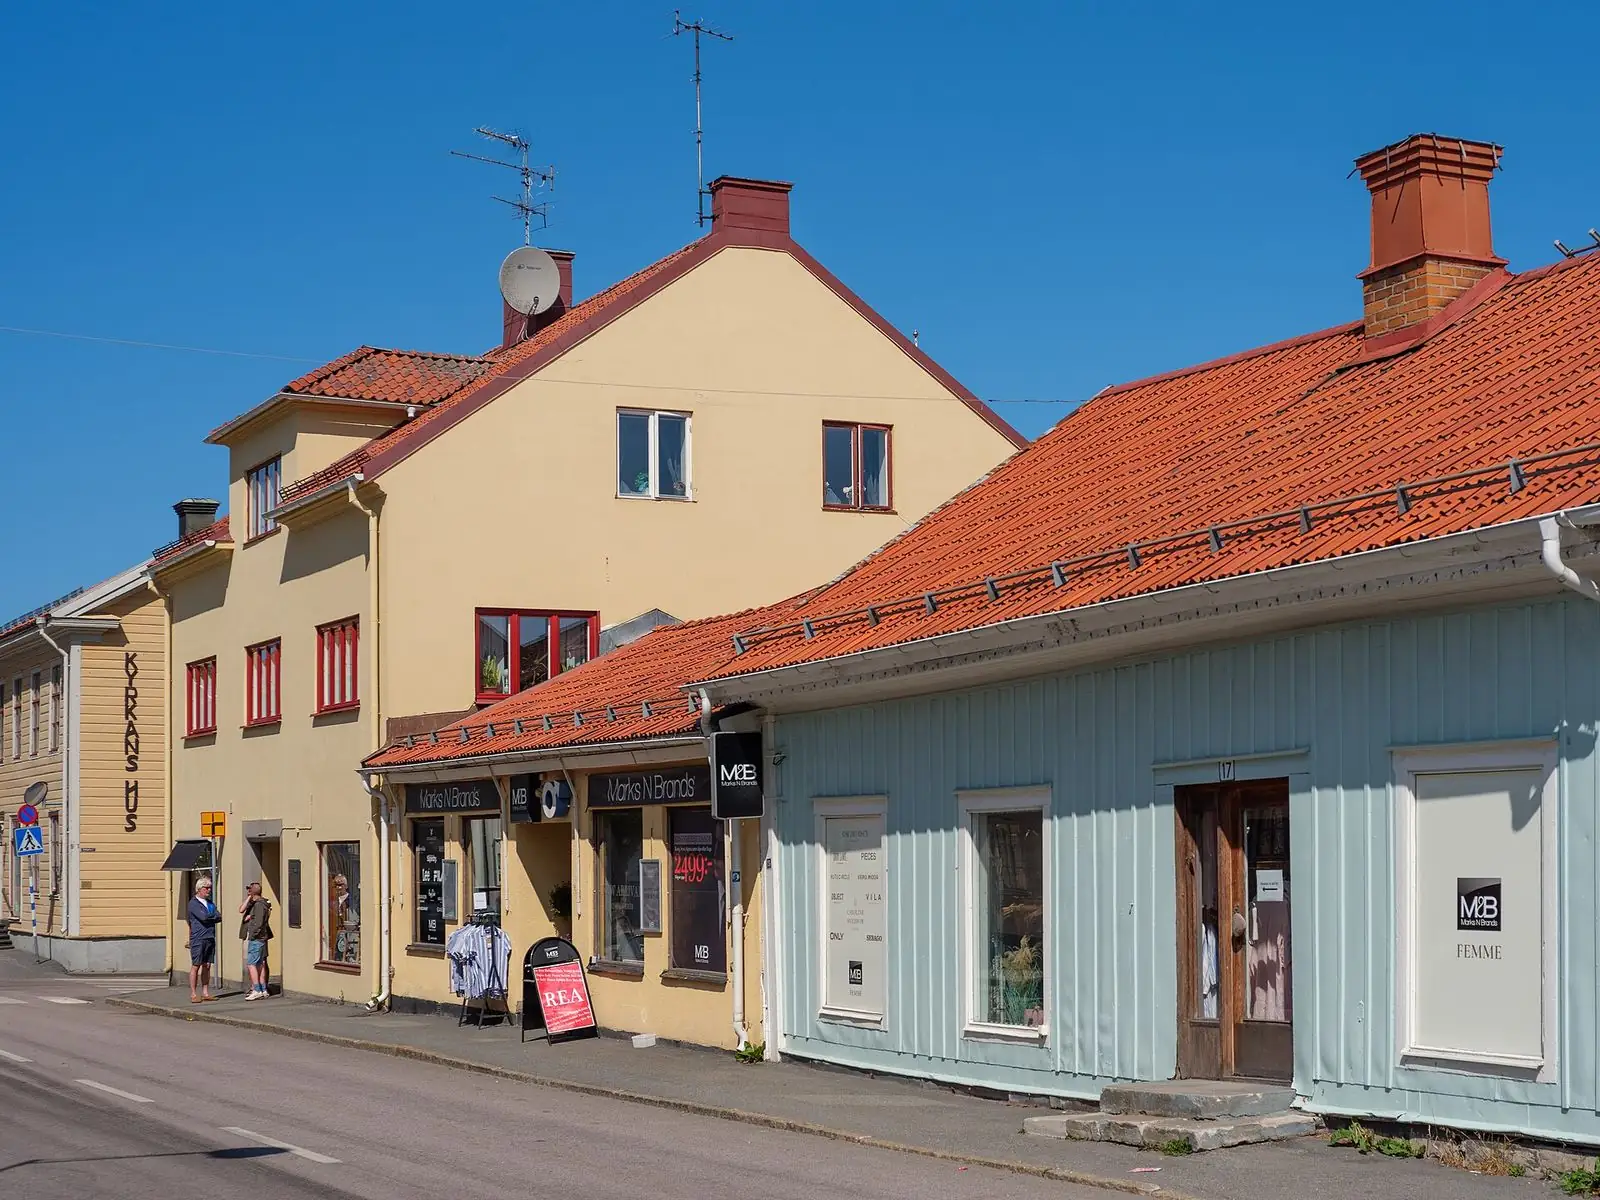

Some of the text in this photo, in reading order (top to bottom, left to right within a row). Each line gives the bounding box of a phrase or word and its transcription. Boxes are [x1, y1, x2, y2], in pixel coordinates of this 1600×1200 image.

[124, 652, 139, 832] KYRKANS HUS
[1221, 762, 1232, 779] 17
[419, 785, 481, 809] Marks N Brands
[607, 771, 695, 802] Marks N Brands
[1456, 943, 1503, 960] FEMME
[543, 987, 585, 1008] REA
